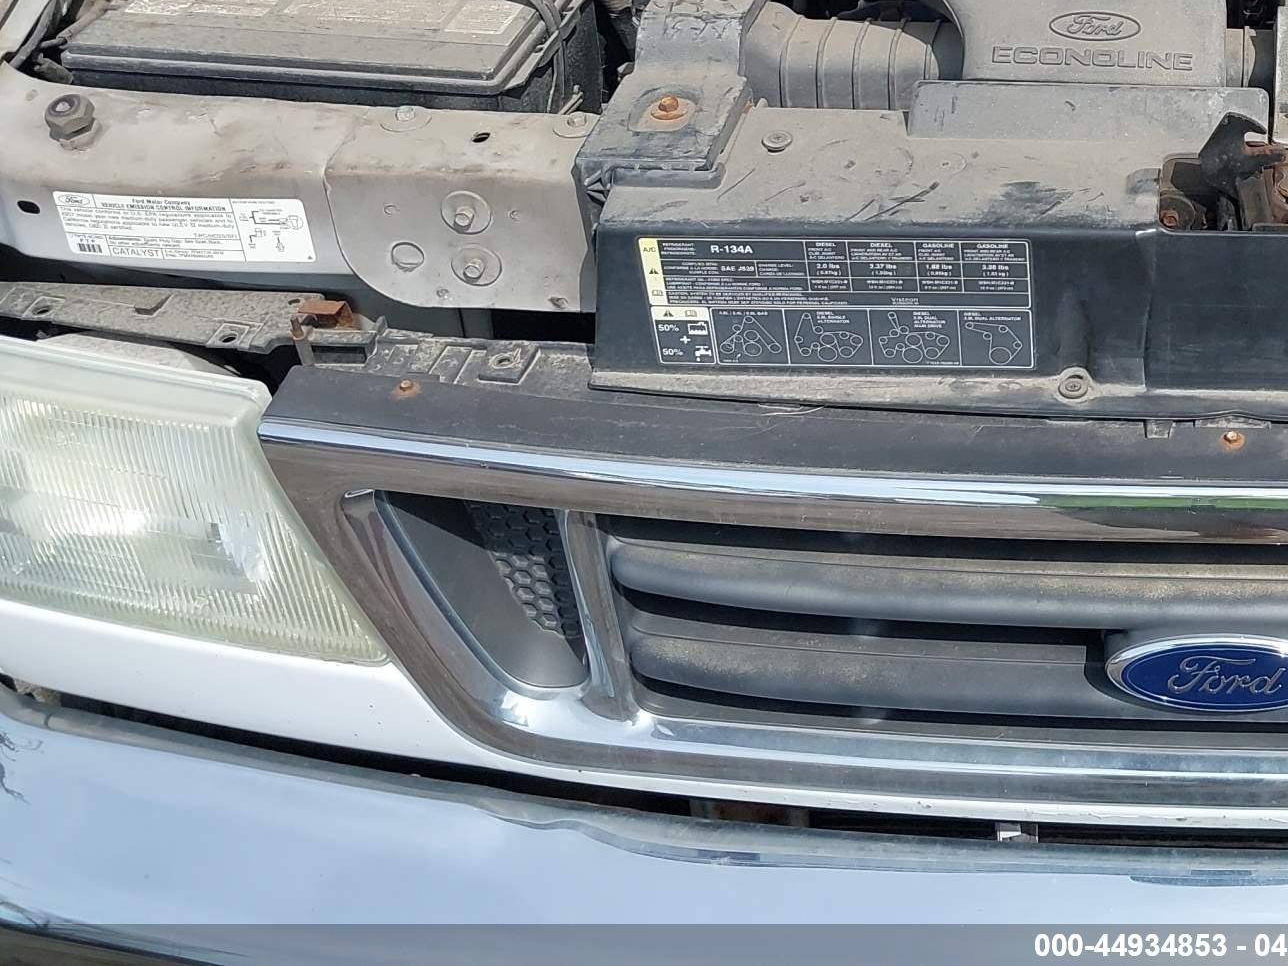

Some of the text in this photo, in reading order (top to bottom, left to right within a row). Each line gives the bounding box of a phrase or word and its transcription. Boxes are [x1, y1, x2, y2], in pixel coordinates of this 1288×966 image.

[1067, 15, 1123, 36] Ford
[992, 46, 1193, 71] ECONOLINE
[112, 247, 159, 257] CATALYST
[710, 244, 753, 254] R-134A
[658, 324, 680, 332] 50%
[662, 348, 684, 356] 50%
[1167, 655, 1287, 695] Ford
